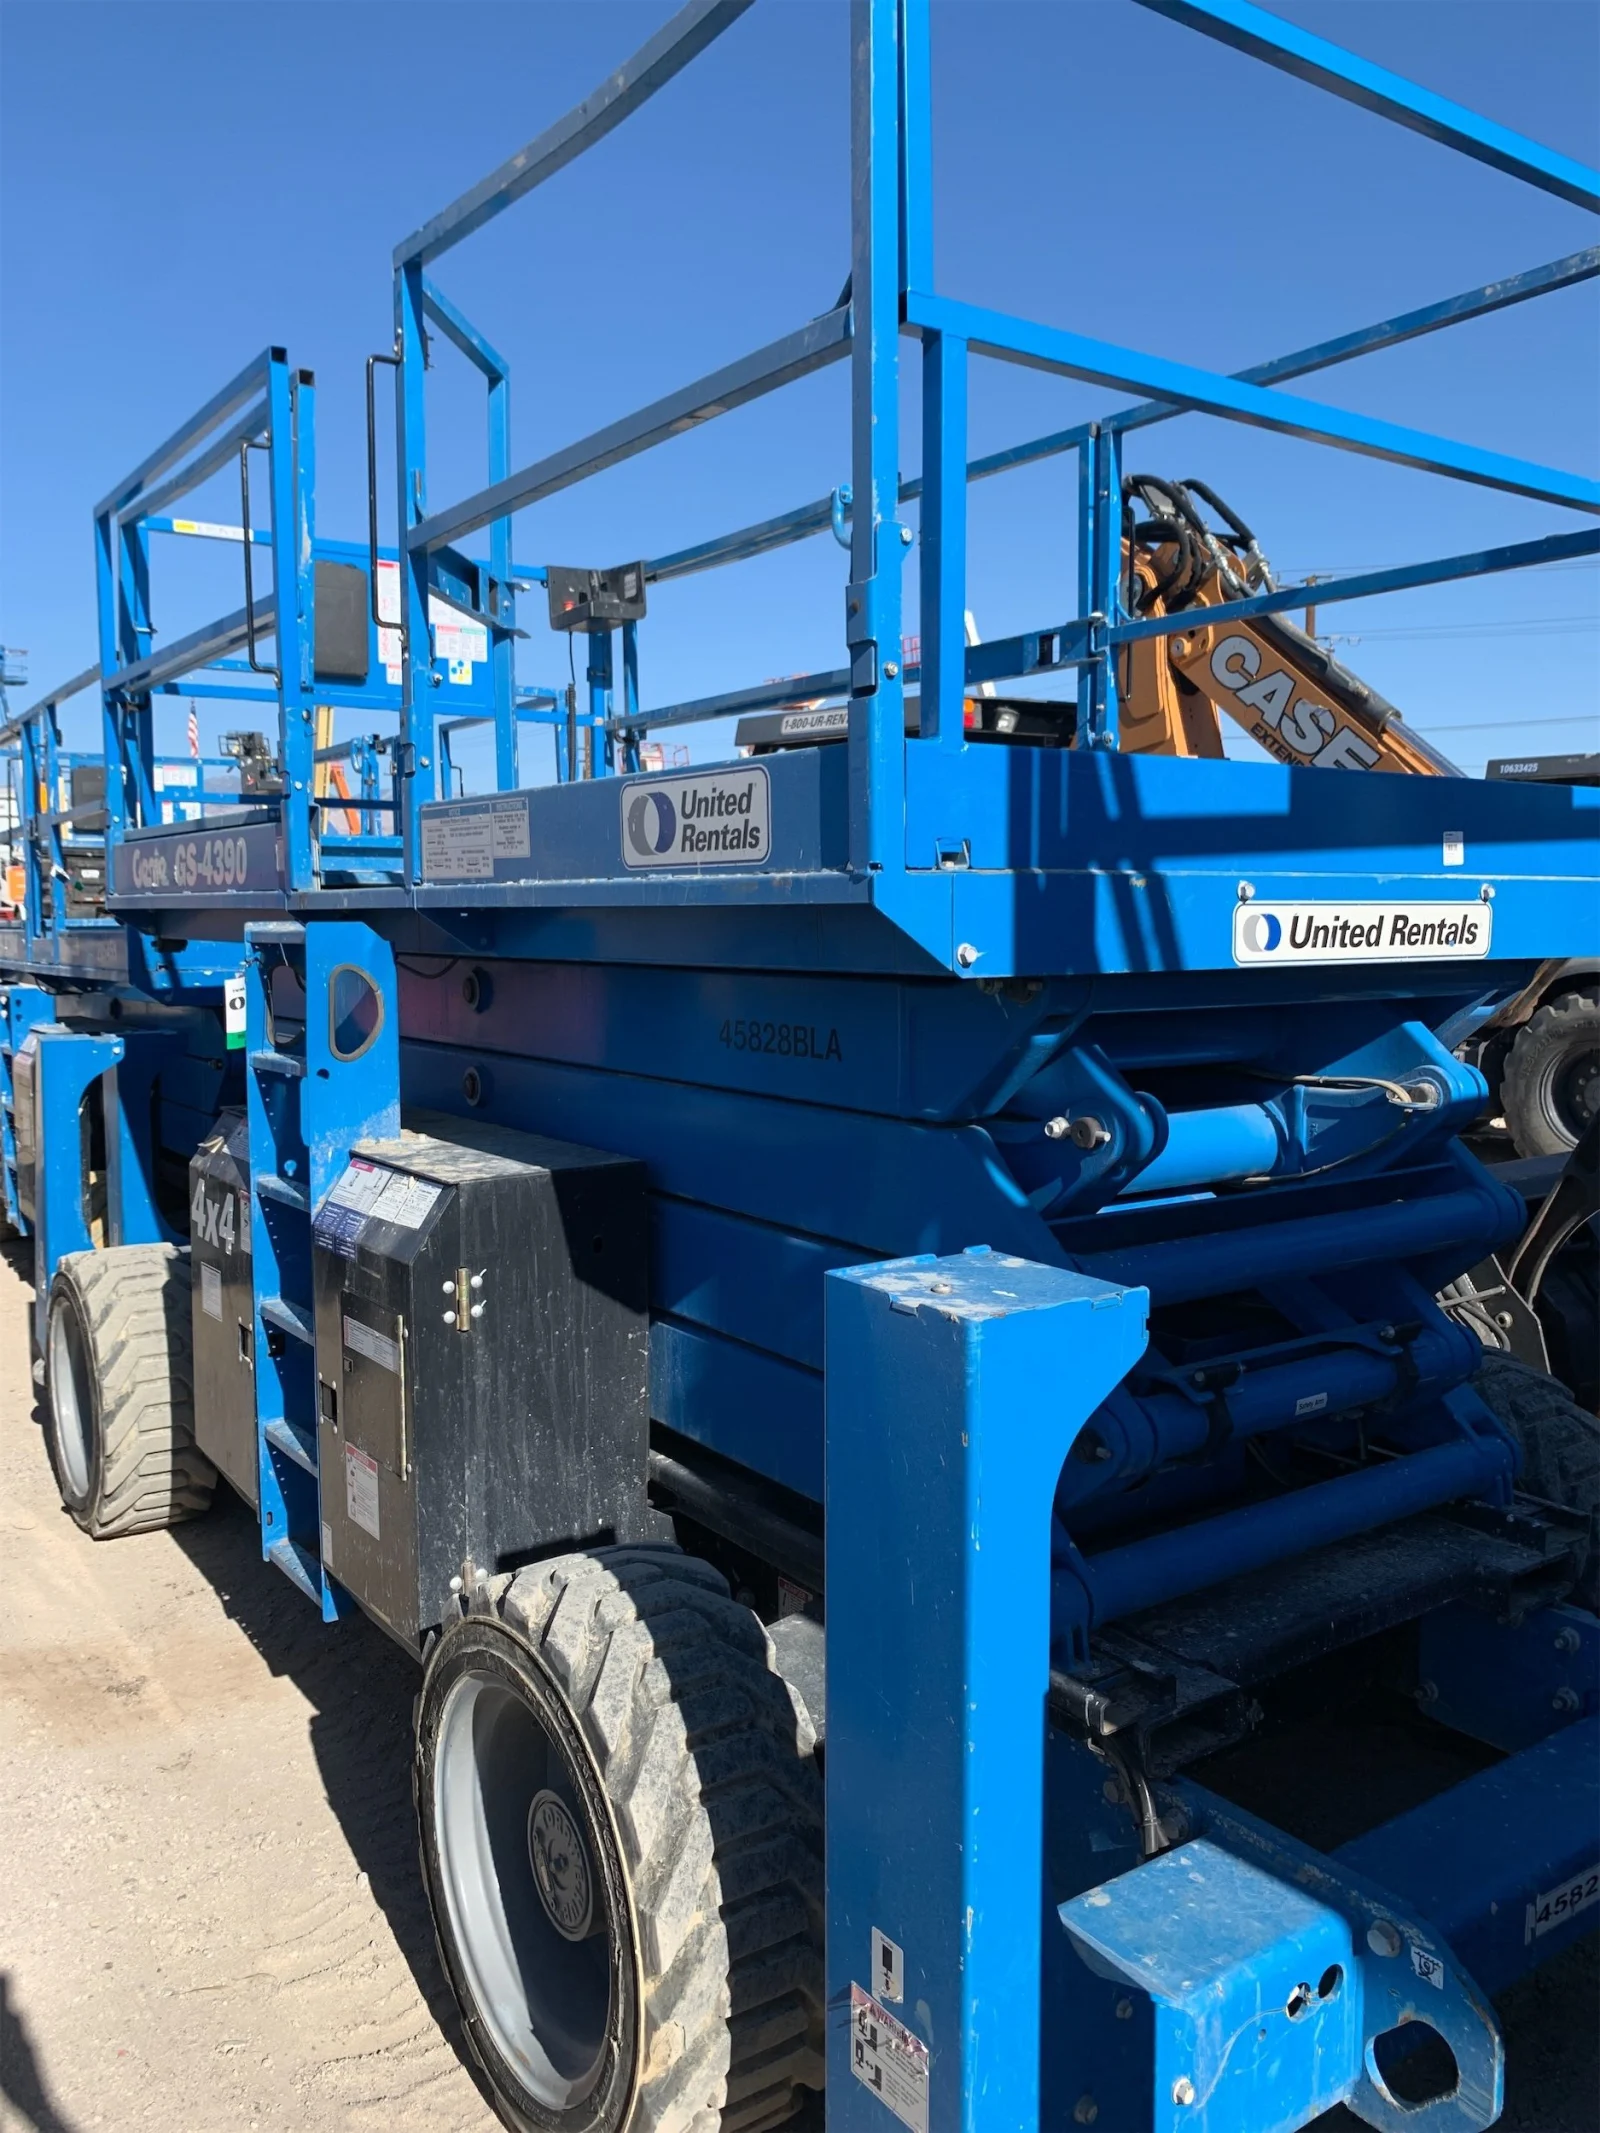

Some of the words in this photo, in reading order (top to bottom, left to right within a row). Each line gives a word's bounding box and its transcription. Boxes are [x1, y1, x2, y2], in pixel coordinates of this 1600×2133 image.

[784, 712, 848, 730] 1-800-UR-REN
[1210, 635, 1383, 771] CASE
[1251, 723, 1306, 767] EXTEN
[1500, 762, 1539, 774] 10633425
[680, 782, 753, 820] United
[680, 818, 761, 853] Rentals
[174, 836, 248, 887] GS-4390
[1289, 914, 1385, 950] United
[1388, 913, 1479, 947] Rentals
[719, 1019, 842, 1061] 45828BLA
[191, 1177, 236, 1257] 4x4
